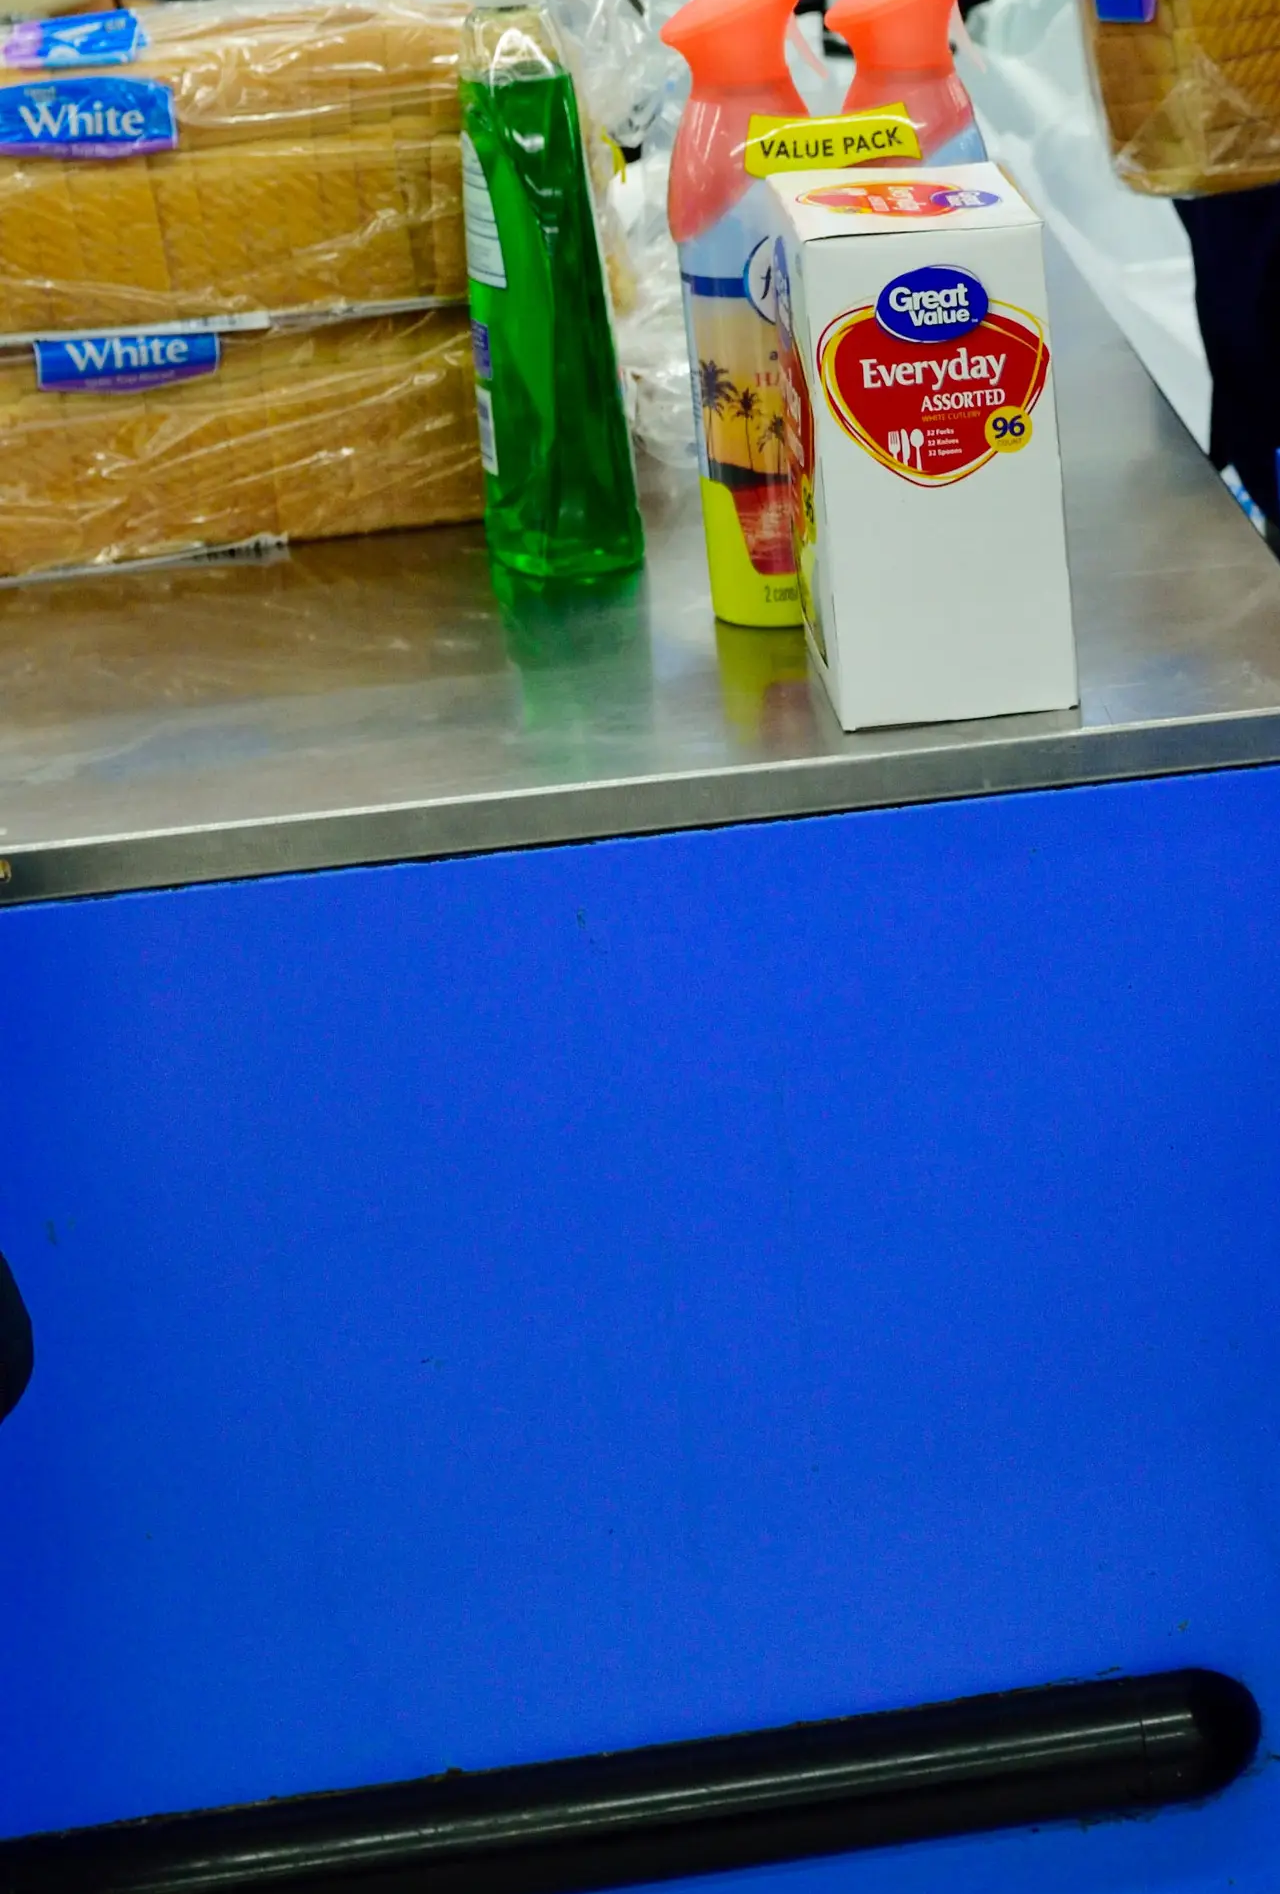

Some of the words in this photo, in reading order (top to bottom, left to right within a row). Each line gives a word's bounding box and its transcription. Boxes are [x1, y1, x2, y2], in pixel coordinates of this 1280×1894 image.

[18, 101, 146, 140] White
[759, 138, 833, 159] VALUE
[842, 127, 904, 156] PACK
[889, 282, 969, 310] Great
[909, 305, 970, 327] Value
[65, 334, 190, 373] White
[859, 347, 1007, 390] Everyday
[921, 388, 1005, 413] ASSORTED
[991, 414, 1025, 439] 96
